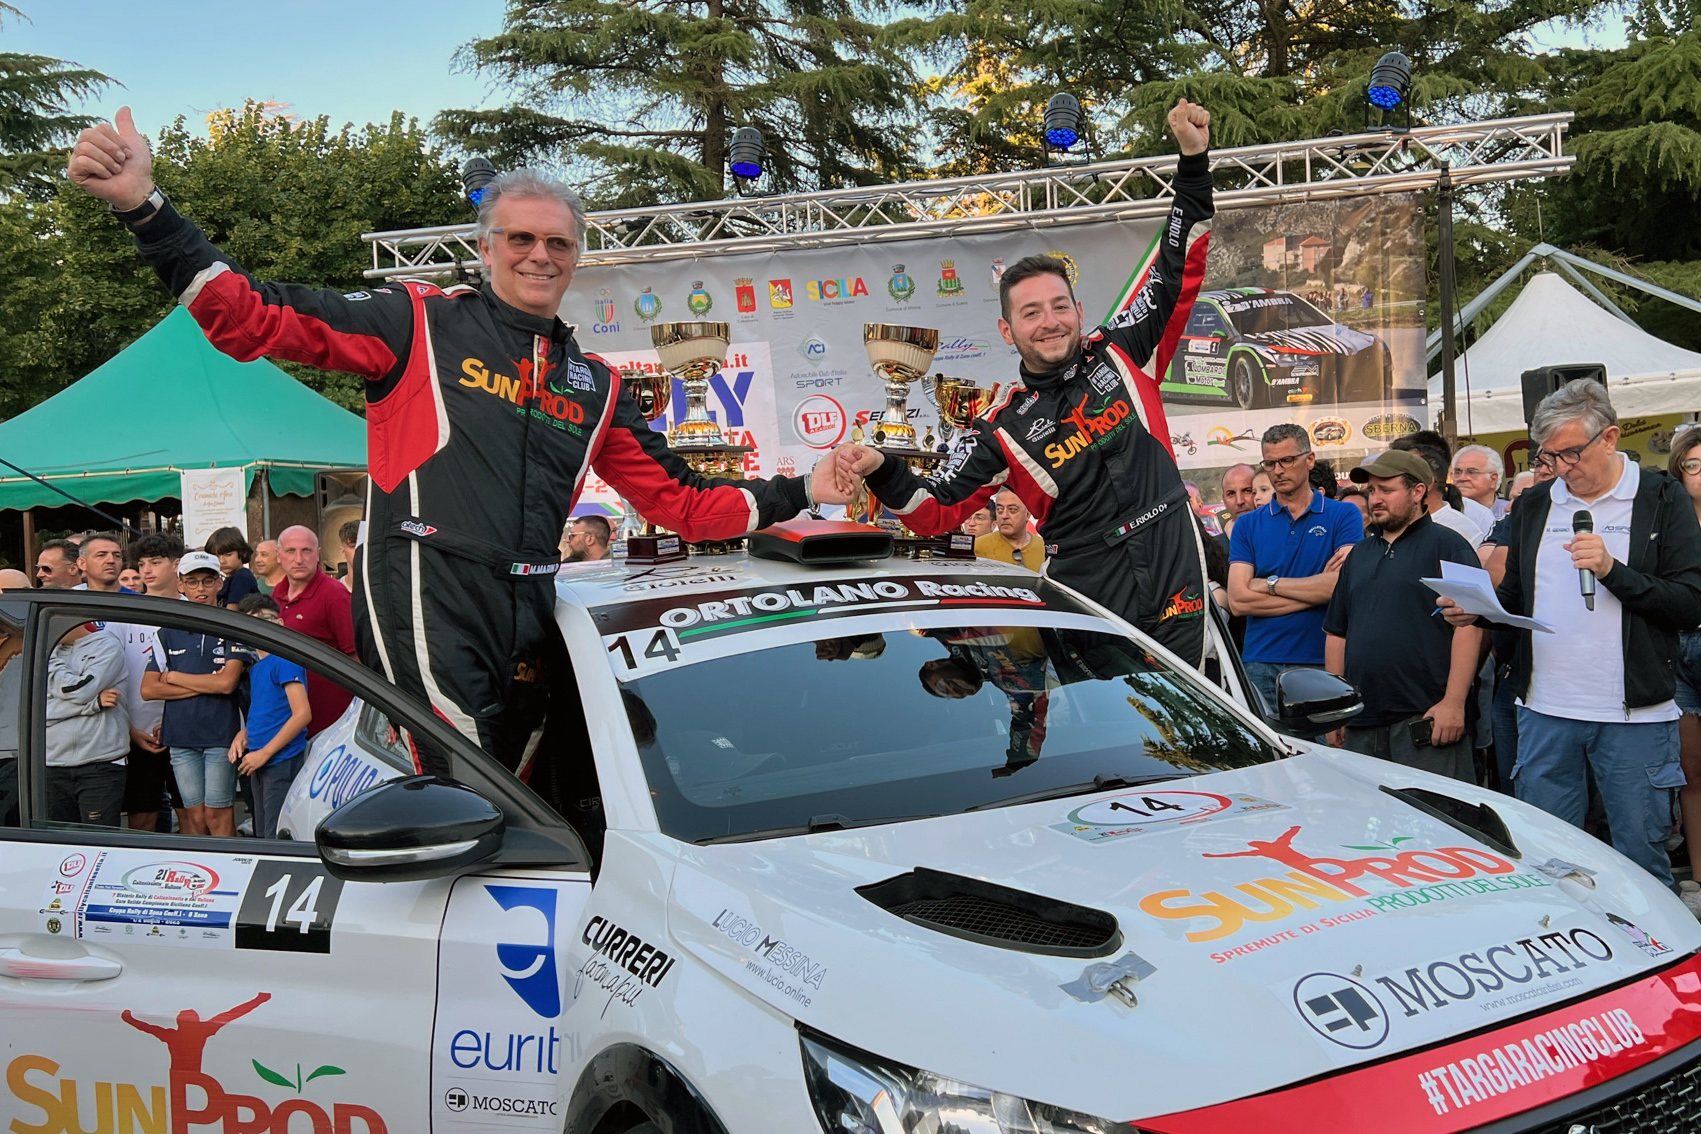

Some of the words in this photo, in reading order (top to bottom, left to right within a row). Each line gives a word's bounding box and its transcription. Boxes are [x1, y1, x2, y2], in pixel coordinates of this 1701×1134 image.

[1168, 206, 1183, 248] E.RIOLO
[806, 277, 869, 300] SICILIA
[592, 321, 620, 334] Coni
[807, 343, 825, 354] ACI
[572, 380, 591, 391] CLUB
[796, 378, 842, 388] SPORT
[806, 412, 838, 429] DLF
[1365, 421, 1418, 434] SBERNA
[777, 457, 795, 466] ARS
[659, 581, 909, 628] ORTOLANO
[913, 580, 1042, 602] Racing
[607, 628, 681, 671] 14
[1109, 796, 1185, 817] 14
[265, 873, 325, 934] 14
[1209, 930, 1299, 964] SPREMUTE
[1299, 922, 1320, 934] DI
[1321, 908, 1378, 929] SICILIA
[1366, 883, 1472, 912] PRODOTTI
[1461, 878, 1508, 894] DEL
[582, 915, 676, 988] CURRERI
[711, 908, 761, 947] LUCIO
[755, 934, 828, 990] MESSINA
[745, 959, 812, 1008] www.lucio.online
[1374, 927, 1613, 1018] MOSCATO
[1417, 1007, 1647, 1116] #TARGARACINGCLUB
